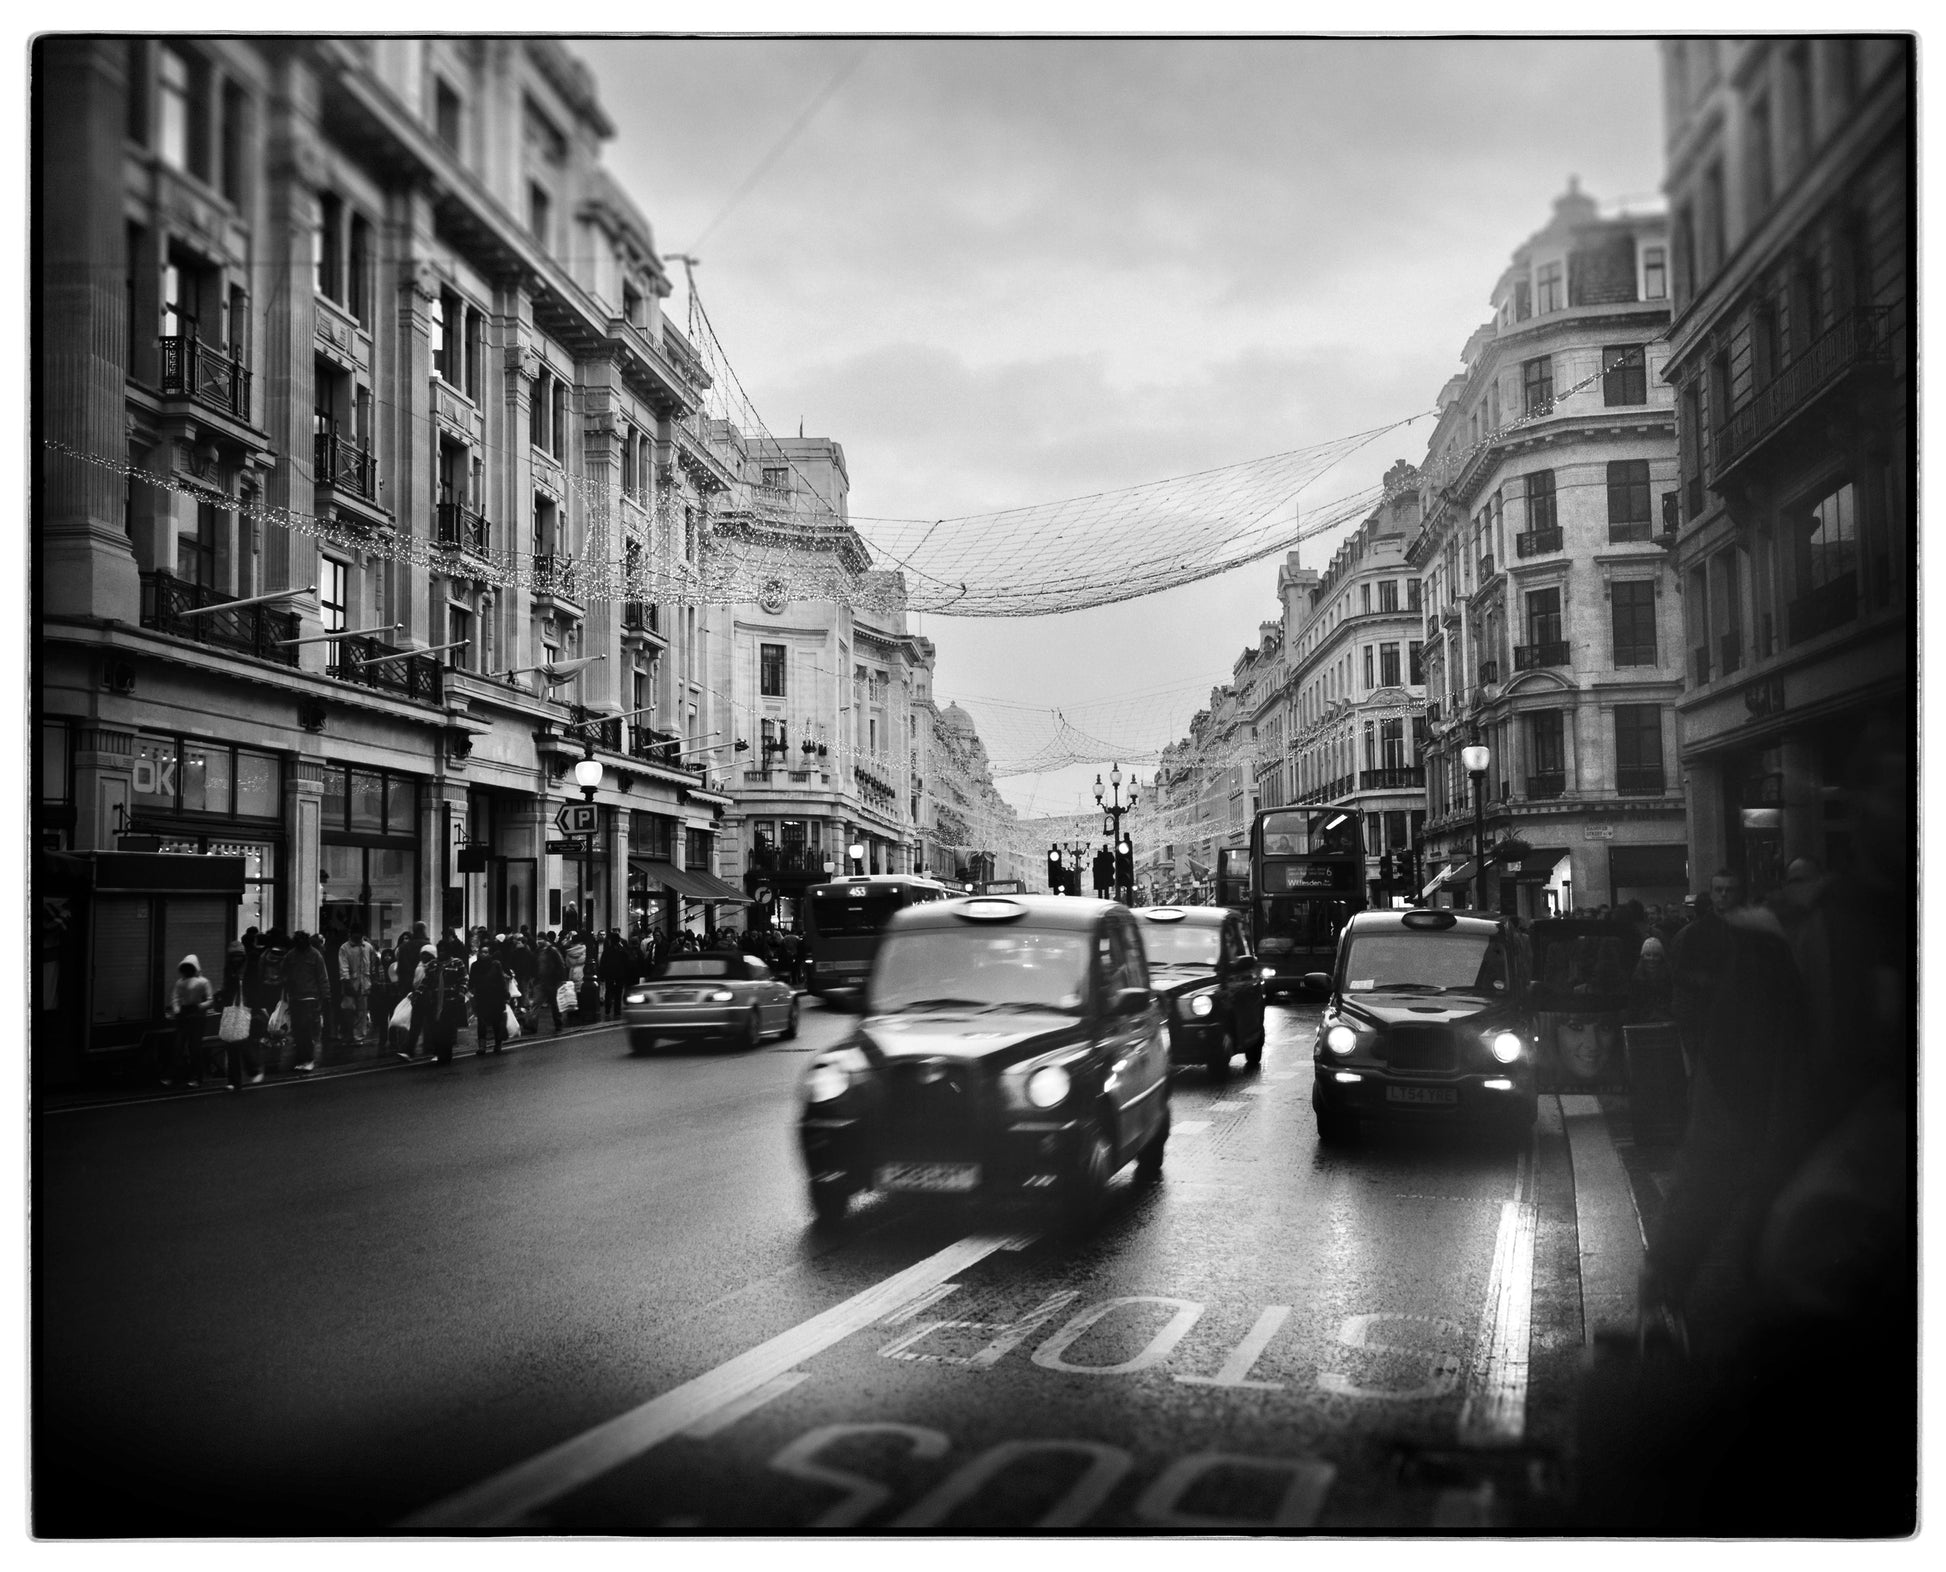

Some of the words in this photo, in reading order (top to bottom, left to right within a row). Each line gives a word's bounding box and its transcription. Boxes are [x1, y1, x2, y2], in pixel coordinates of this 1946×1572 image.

[578, 810, 591, 827] P
[1326, 867, 1332, 876] 6
[1287, 879, 1322, 887] Willesden
[848, 886, 866, 897] 453
[877, 1289, 1464, 1401] STOP
